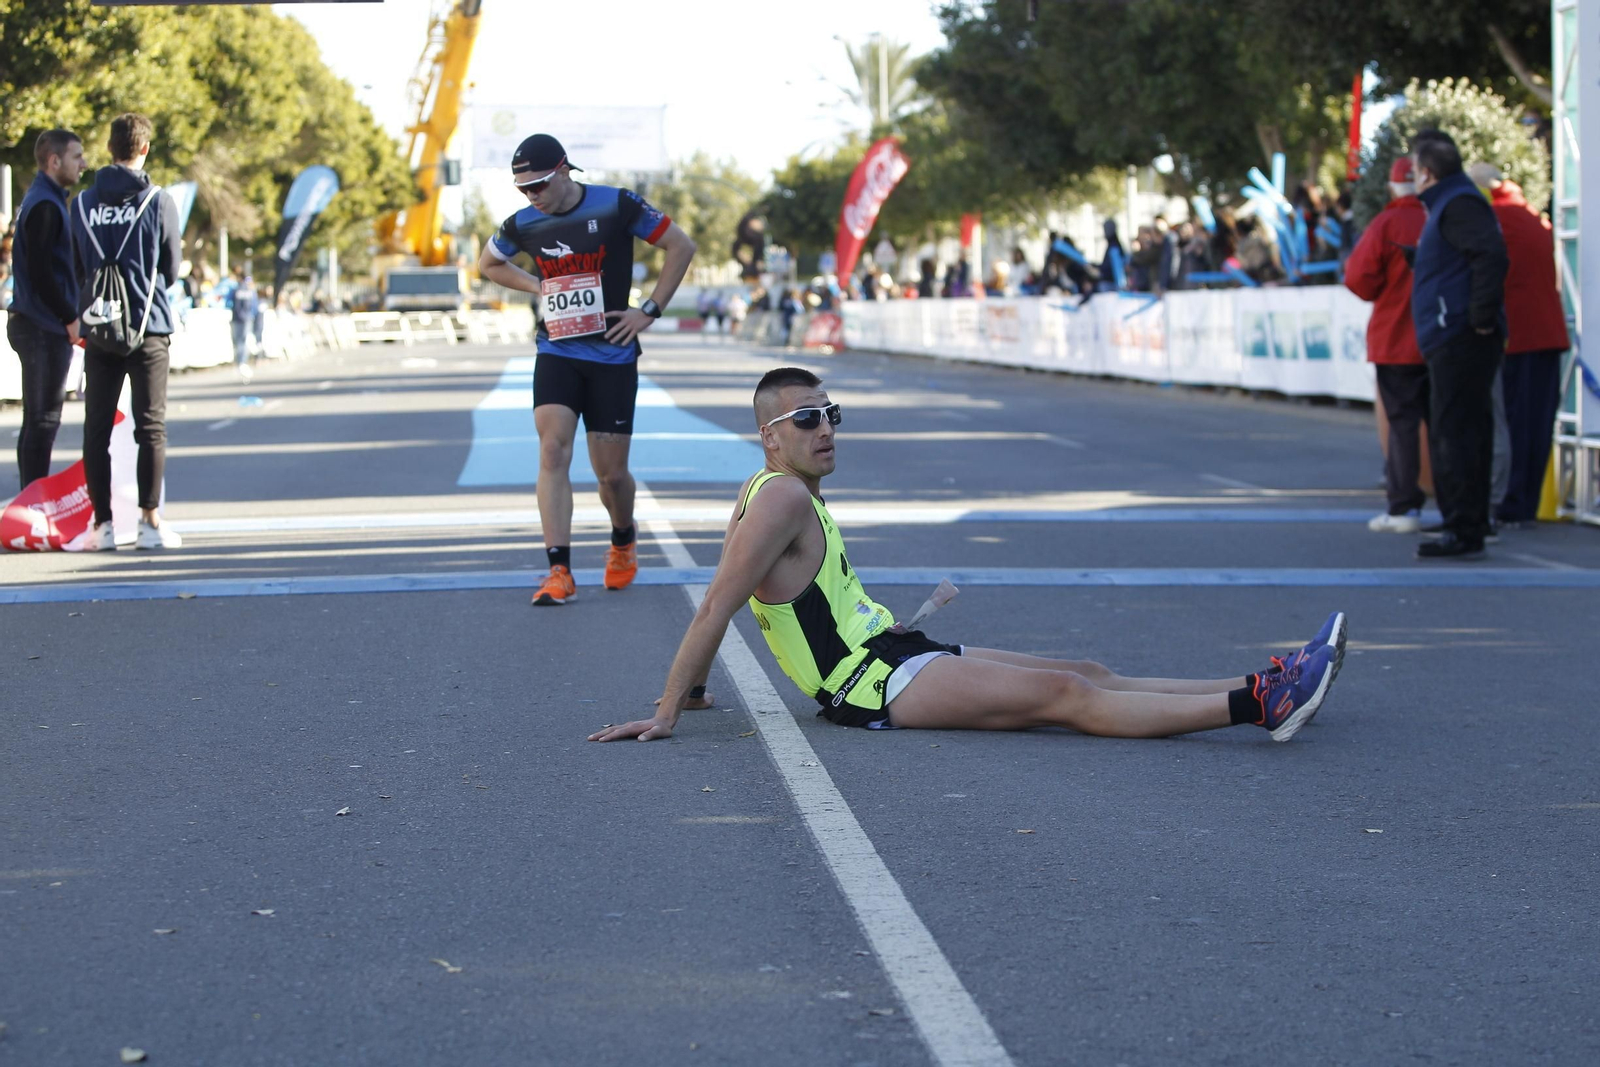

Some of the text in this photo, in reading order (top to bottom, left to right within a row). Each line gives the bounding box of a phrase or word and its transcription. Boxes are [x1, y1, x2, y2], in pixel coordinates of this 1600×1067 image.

[89, 205, 136, 227] NEXA
[547, 289, 595, 312] 5040
[844, 663, 868, 692] Kalenji
